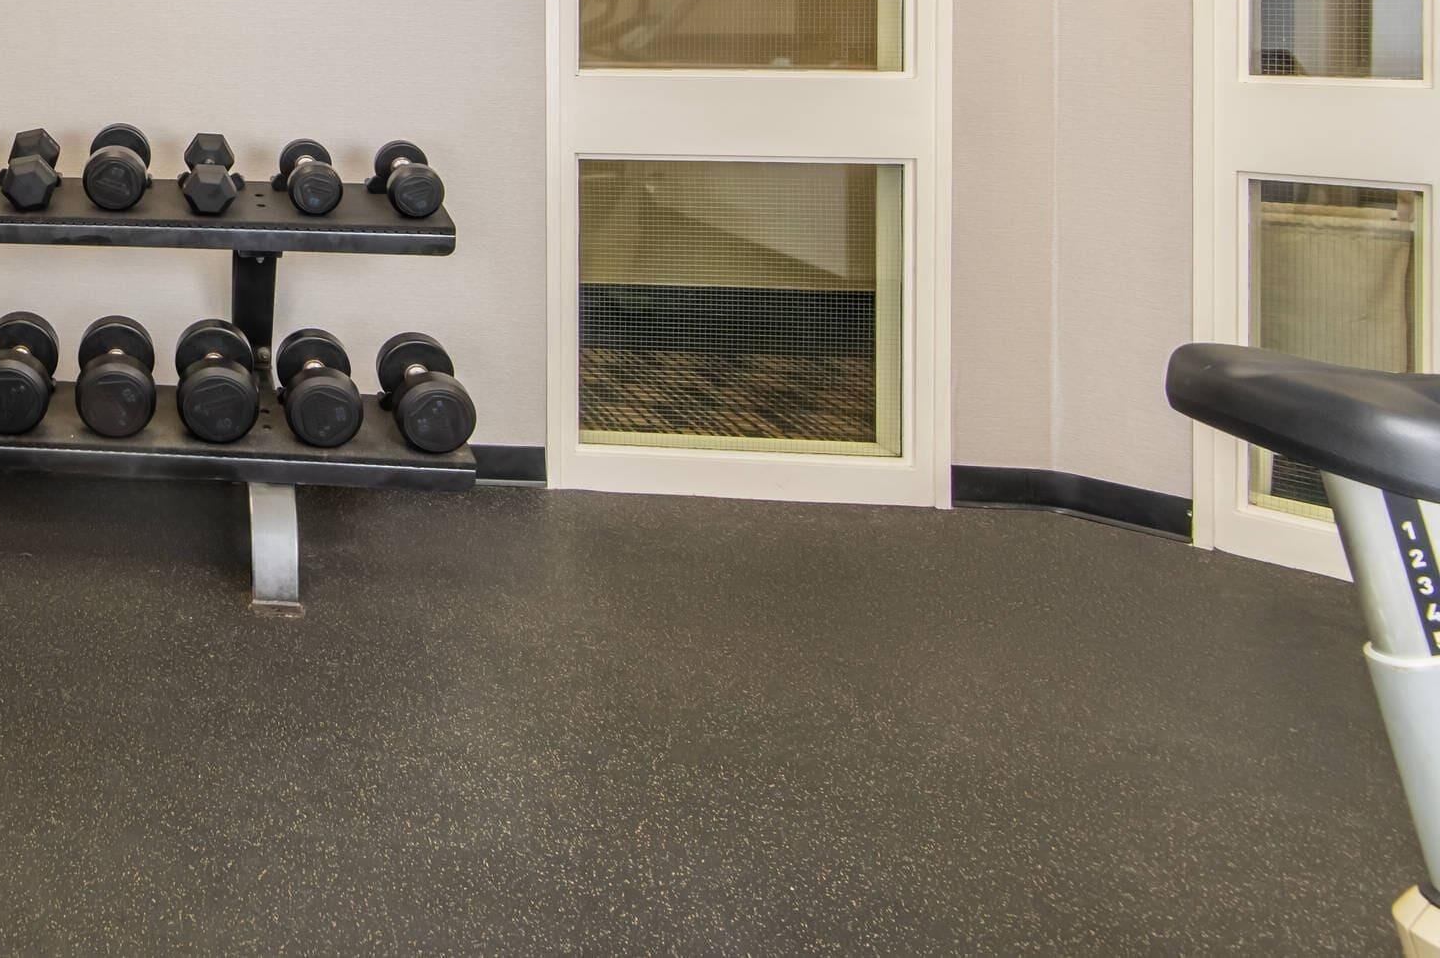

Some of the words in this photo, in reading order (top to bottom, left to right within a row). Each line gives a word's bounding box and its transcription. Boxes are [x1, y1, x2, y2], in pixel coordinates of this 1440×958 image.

[1401, 521, 1416, 540] 1
[1409, 549, 1427, 568] 2
[1417, 576, 1434, 595] 3
[1426, 603, 1440, 621] 4
